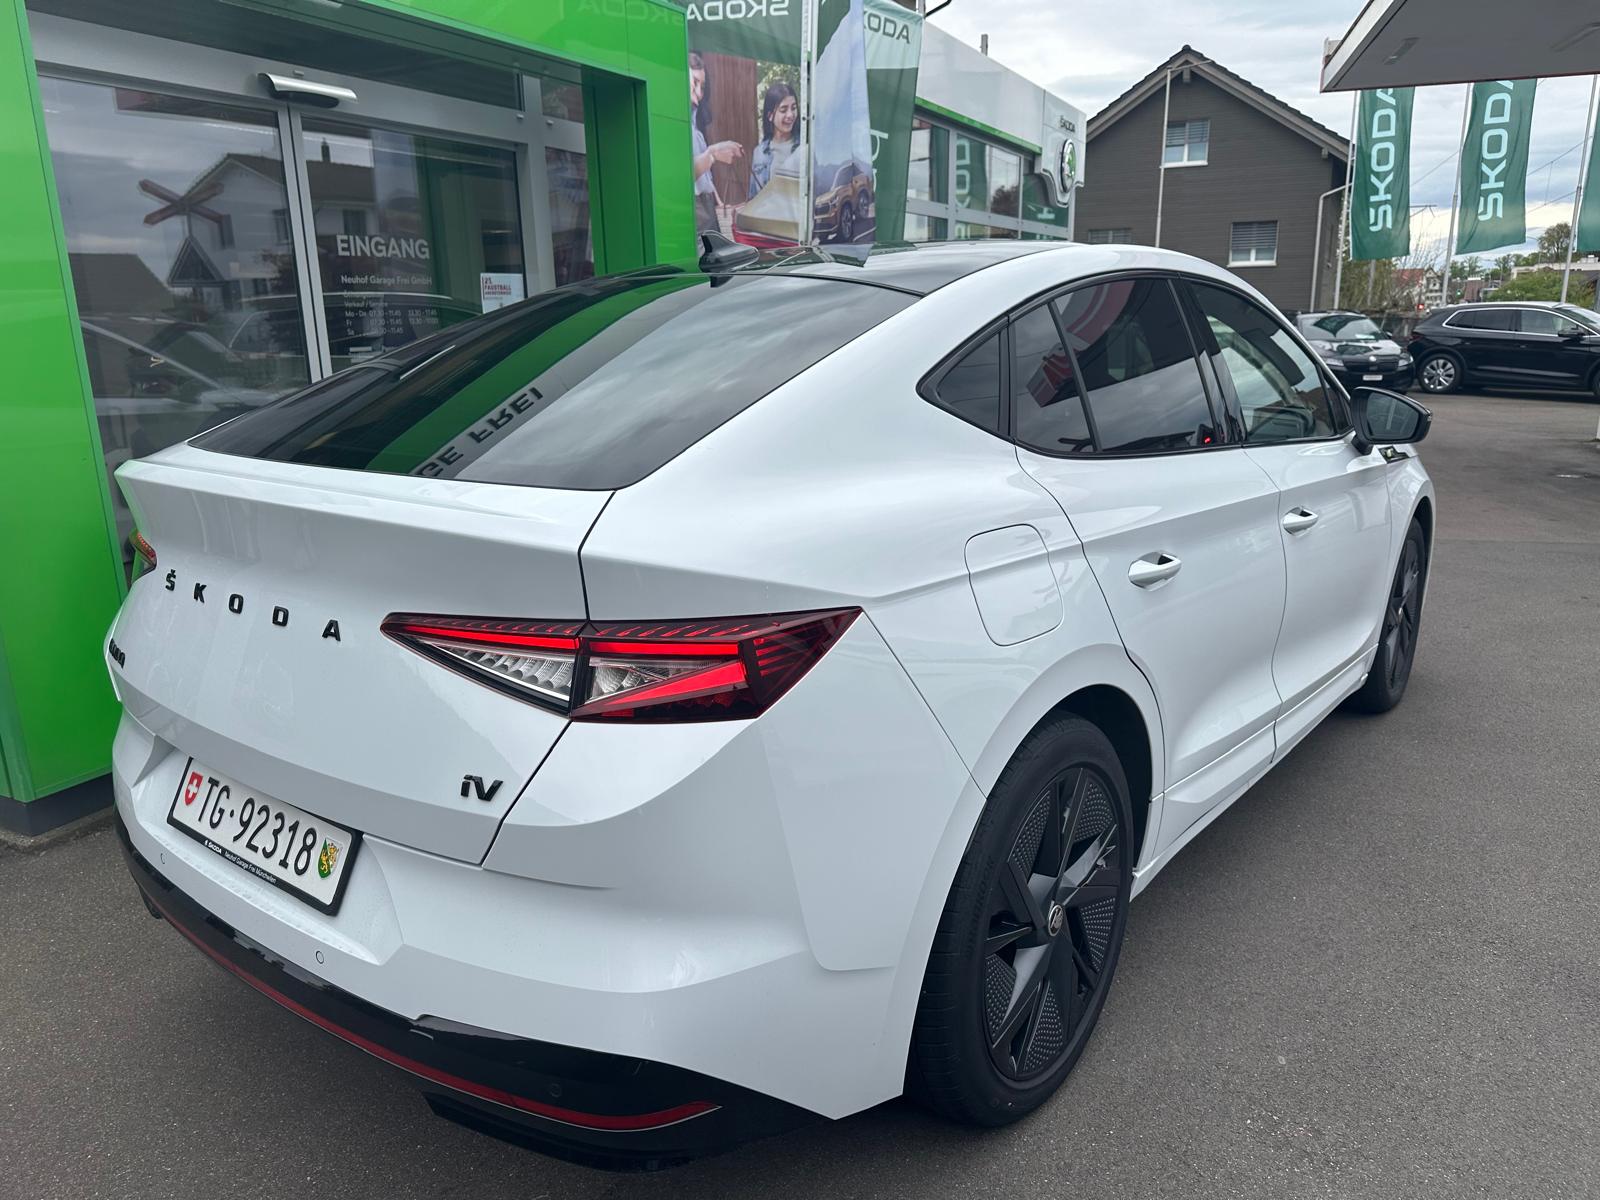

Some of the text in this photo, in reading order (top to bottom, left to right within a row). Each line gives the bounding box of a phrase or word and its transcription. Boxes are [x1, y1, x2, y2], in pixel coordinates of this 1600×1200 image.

[337, 235, 430, 259] EINGANG
[341, 275, 368, 285] Neuhof
[370, 275, 394, 287] Garage
[396, 276, 410, 285] Frei
[165, 569, 341, 642] ŠKODA
[461, 774, 504, 802] iV
